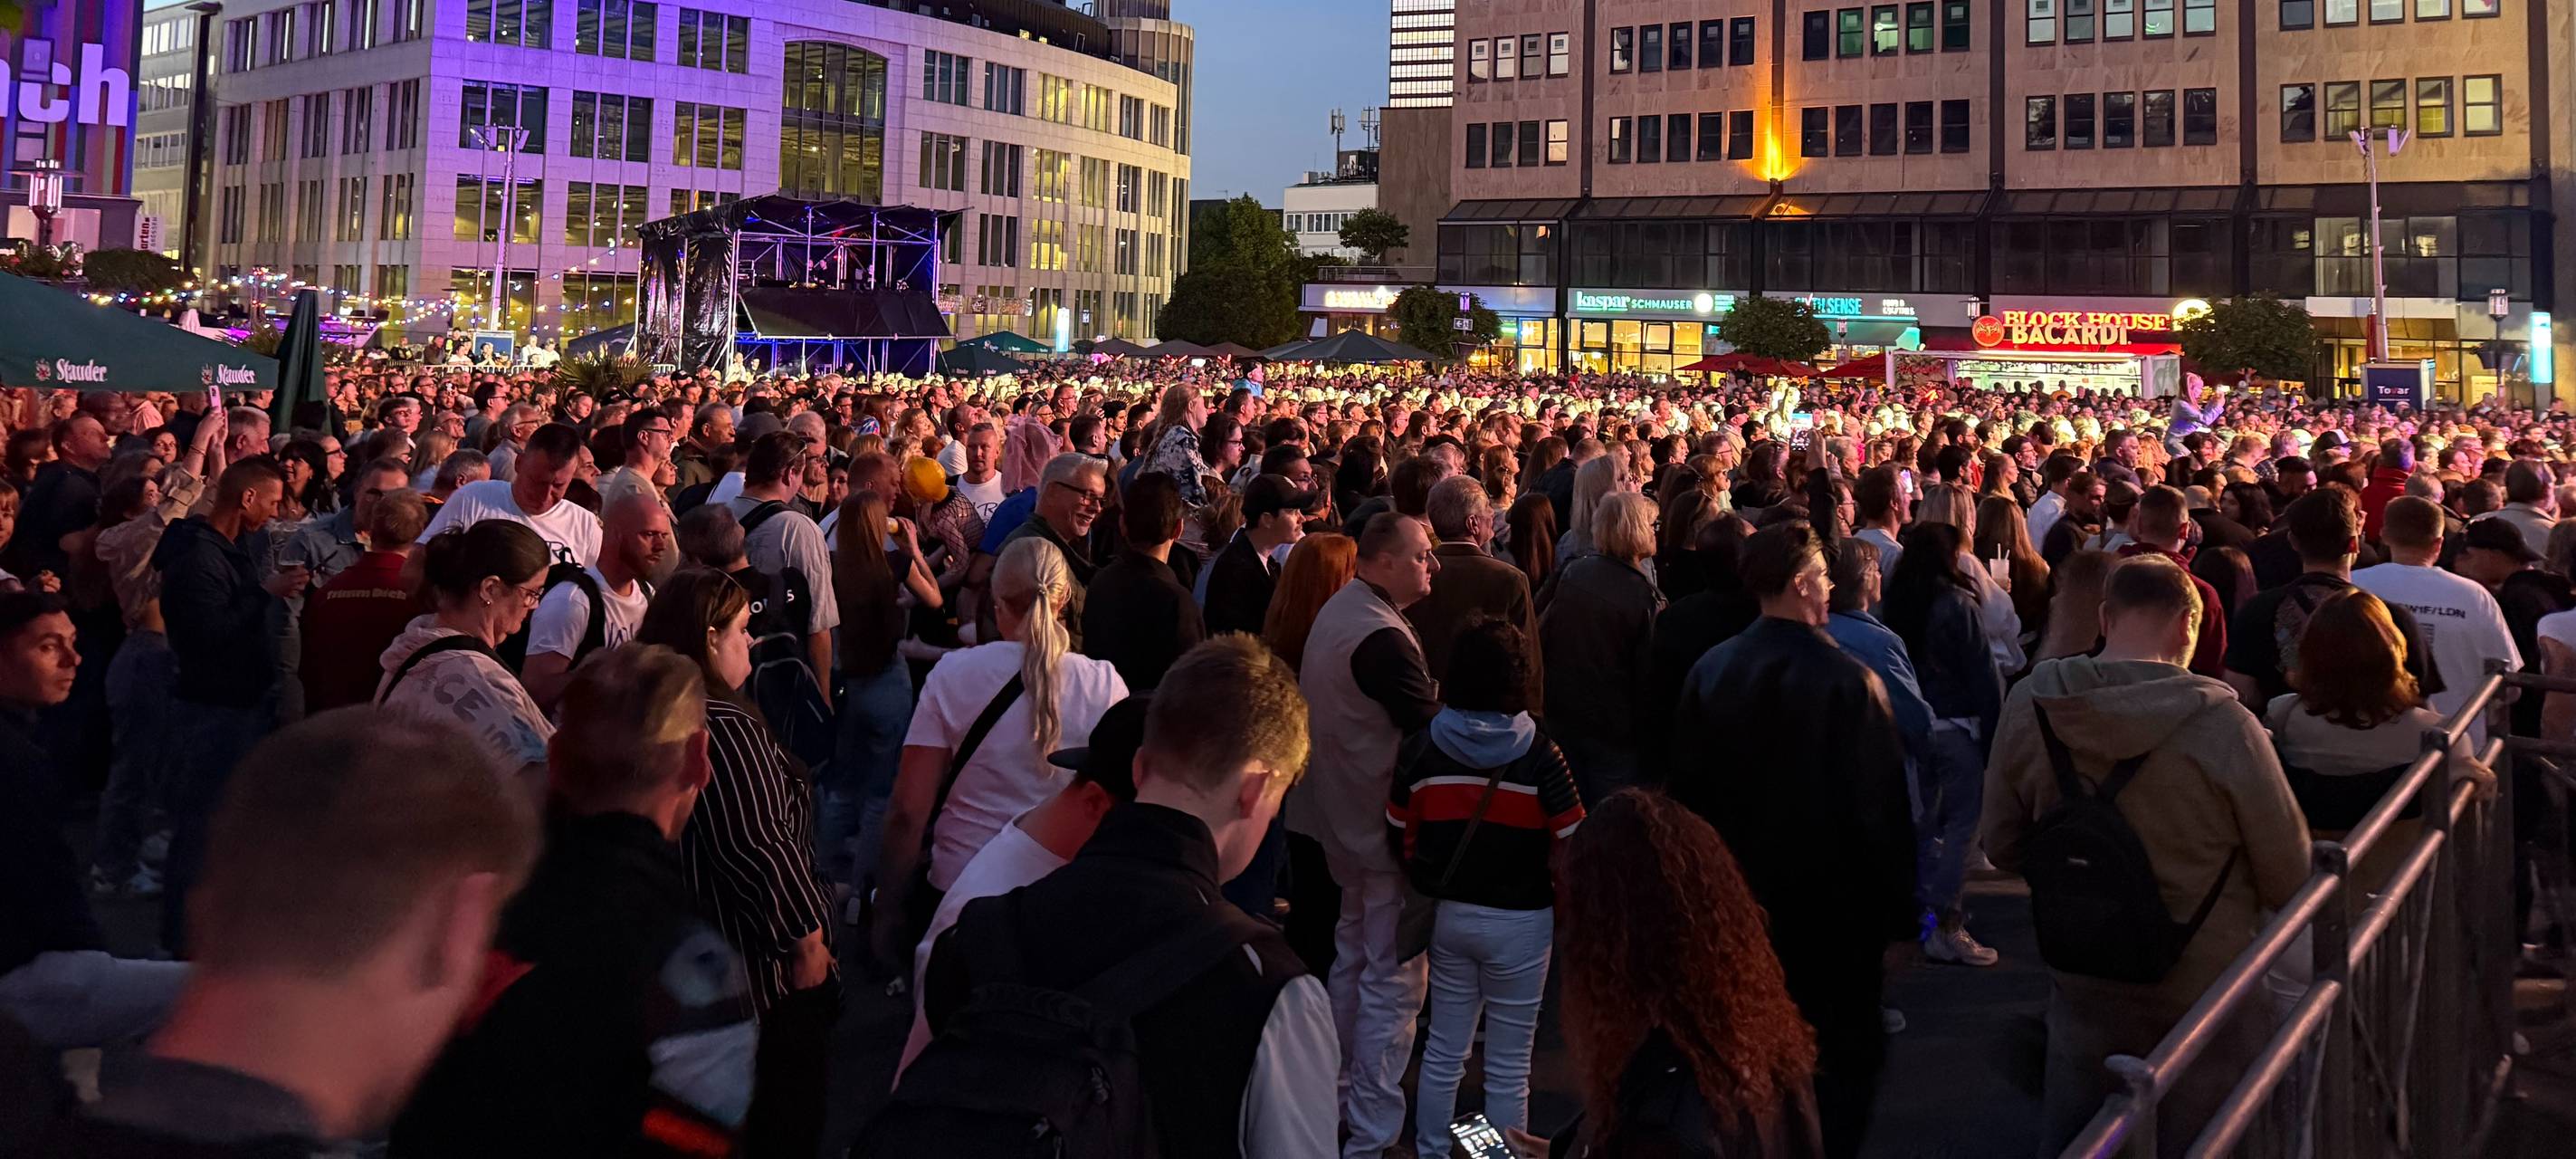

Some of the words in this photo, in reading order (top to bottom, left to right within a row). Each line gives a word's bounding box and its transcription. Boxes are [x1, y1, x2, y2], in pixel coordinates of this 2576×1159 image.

[0, 43, 130, 127] ch
[1631, 298, 1693, 310] SCHMAUSER
[1827, 297, 1862, 315] SENSE
[2002, 311, 2083, 330] BLOCK
[2086, 312, 2171, 331] HOUSE
[56, 358, 108, 384] Stauder
[216, 363, 257, 386] Stauder
